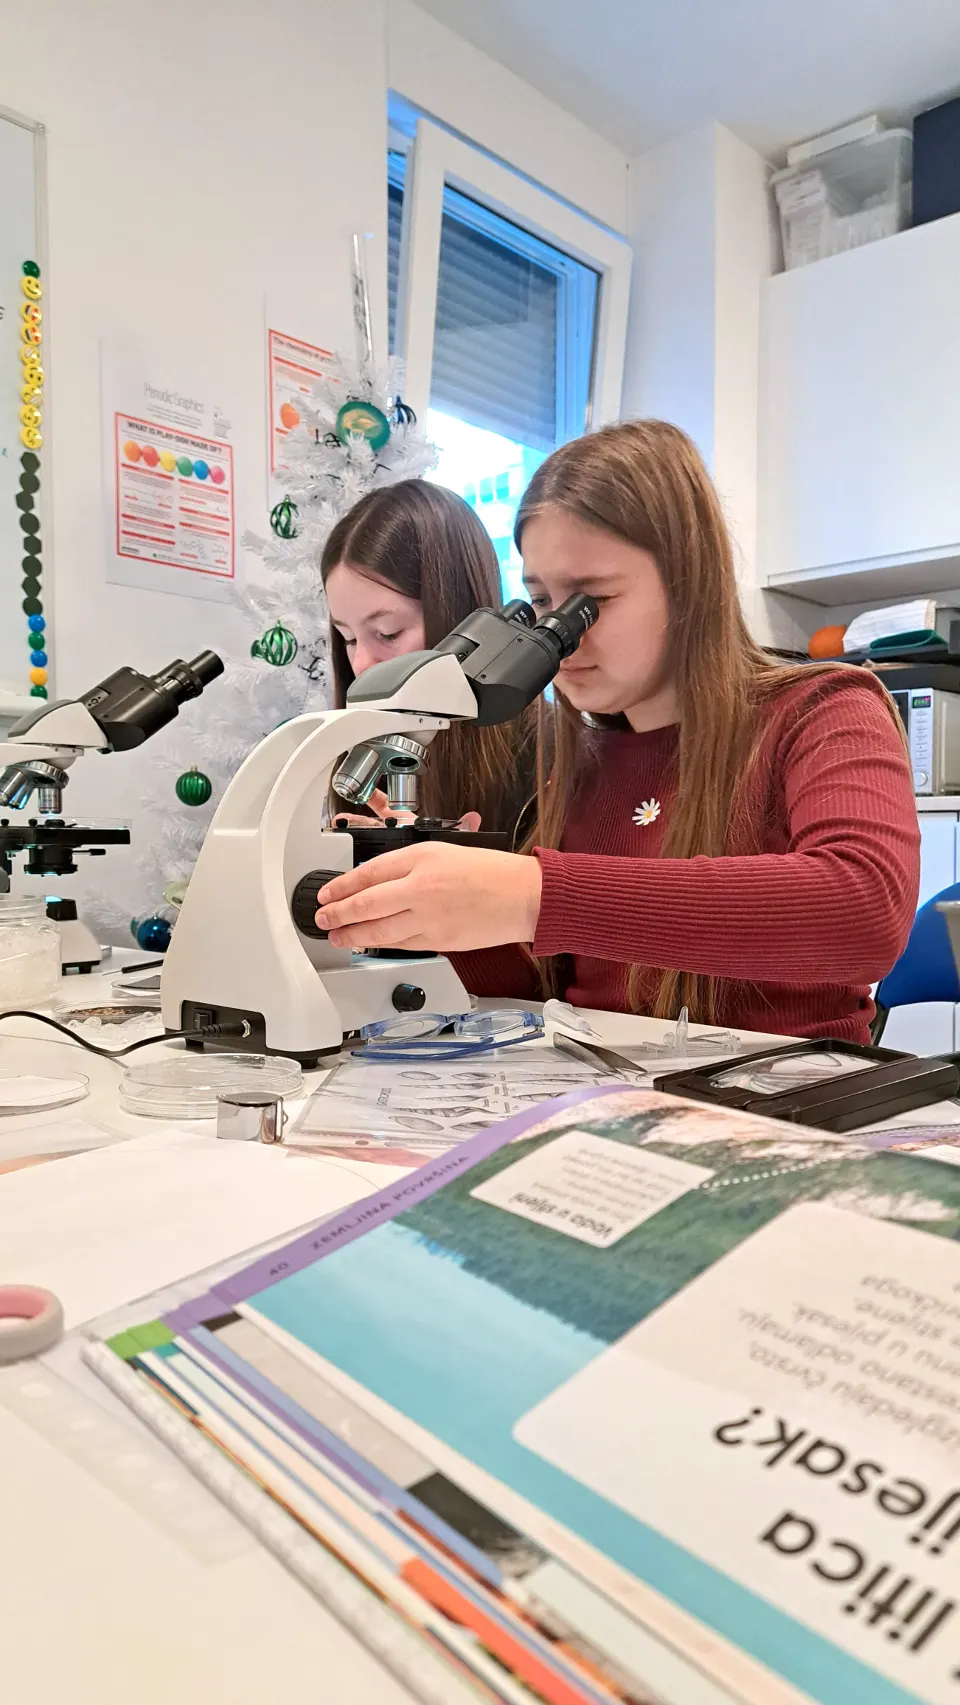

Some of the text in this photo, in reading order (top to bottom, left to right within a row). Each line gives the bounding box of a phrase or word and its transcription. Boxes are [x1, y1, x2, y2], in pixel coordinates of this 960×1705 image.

[127, 421, 147, 433] WHAT
[190, 440, 208, 451] MADE
[268, 1156, 469, 1276] 40 ZEMLJINA POVRŠINA
[508, 1191, 557, 1213] stijeni
[570, 1214, 613, 1239] Voda
[886, 1339, 909, 1356] u
[714, 1407, 960, 1553] ijesak?
[761, 1511, 955, 1652] litica
